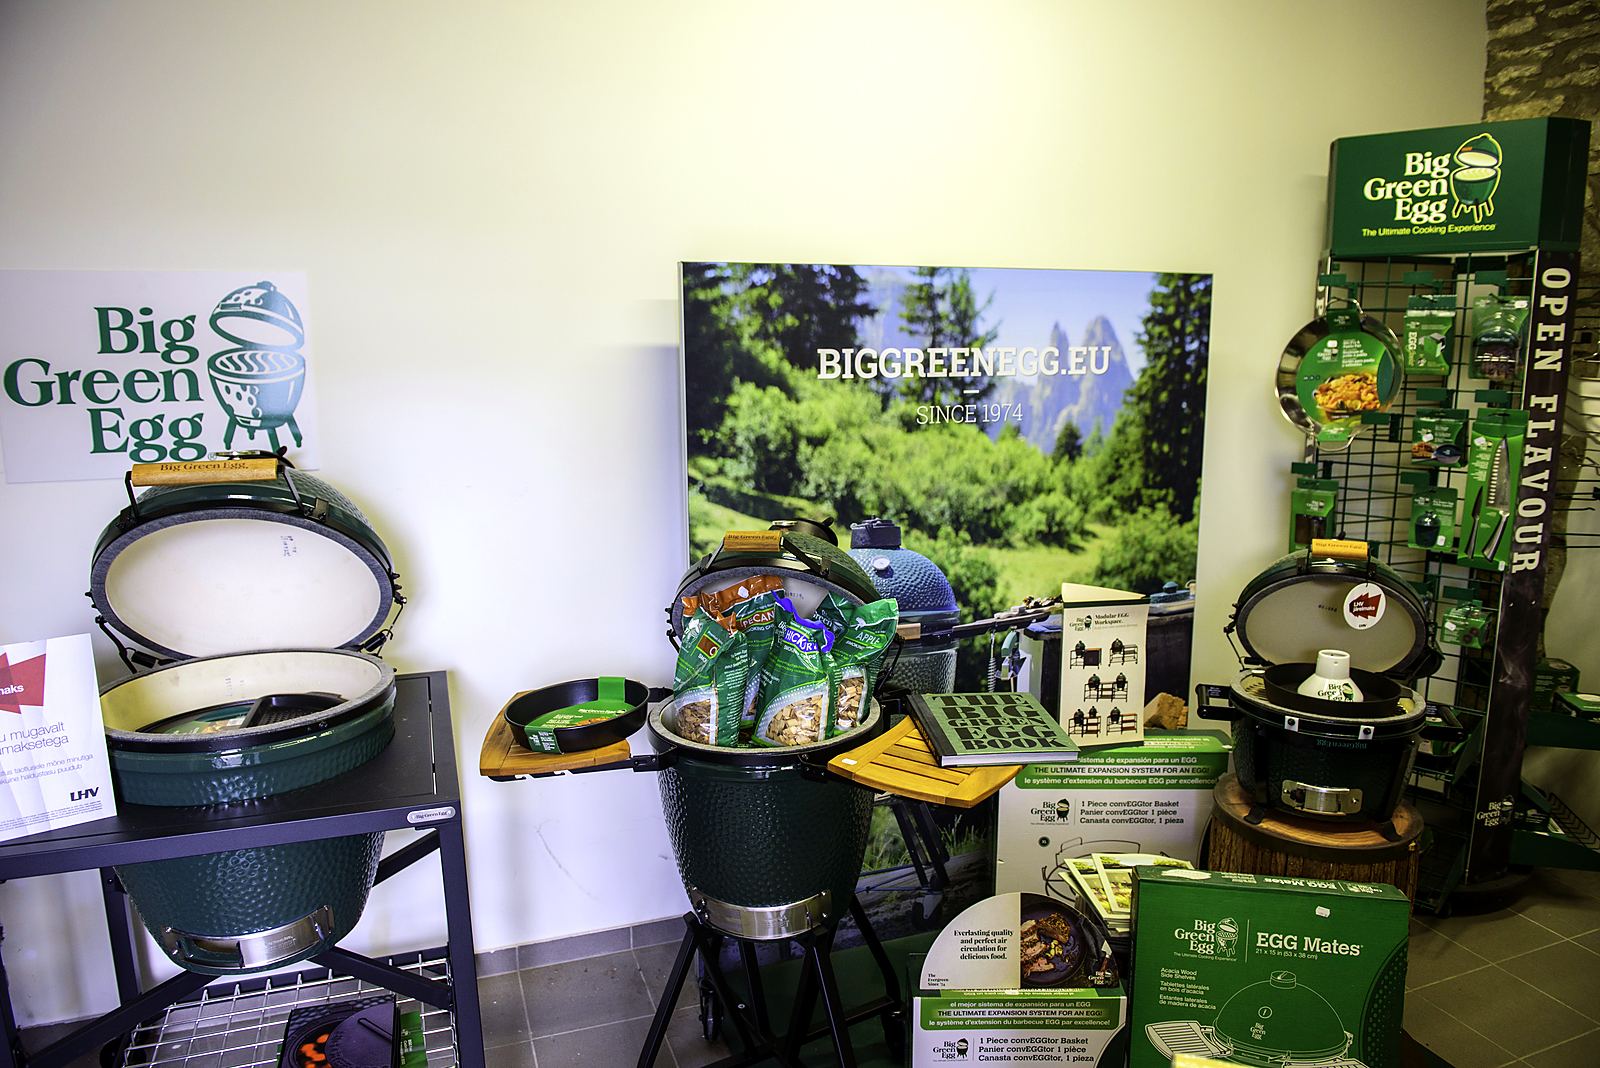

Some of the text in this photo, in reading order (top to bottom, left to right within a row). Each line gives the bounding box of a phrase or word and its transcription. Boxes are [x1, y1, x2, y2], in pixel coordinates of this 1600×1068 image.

[1404, 152, 1451, 178] Big
[1364, 178, 1448, 200] Green
[1394, 198, 1448, 224] Egg
[1362, 224, 1495, 236] The Ultimate Cooking Experience
[94, 306, 200, 364] Big
[817, 346, 1112, 380] BIGGREENEGG.EU
[4, 358, 204, 407] Green
[916, 402, 1023, 426] SINCE 1974
[1512, 267, 1572, 573] OPEN FLAVOUR
[87, 408, 208, 463] Egg
[932, 694, 1029, 706] THE
[942, 705, 1042, 719] BIG
[948, 718, 1047, 727] GREEN
[10, 722, 65, 740] mugavalt
[954, 725, 1057, 740] EGG
[960, 738, 1069, 750] BOOK
[1116, 756, 1152, 765] expansión
[1032, 777, 1061, 786] système
[70, 787, 99, 801] LHV
[1043, 801, 1056, 810] Big
[1489, 801, 1501, 810] Big
[1476, 811, 1500, 820] Green
[1484, 818, 1499, 826] Egg
[1194, 920, 1215, 934] Big
[1174, 929, 1215, 941] Green
[1190, 940, 1215, 955] Egg
[1256, 932, 1361, 956] EGG Mates
[1014, 1001, 1048, 1009] expansión
[1063, 1046, 1086, 1054] pièce
